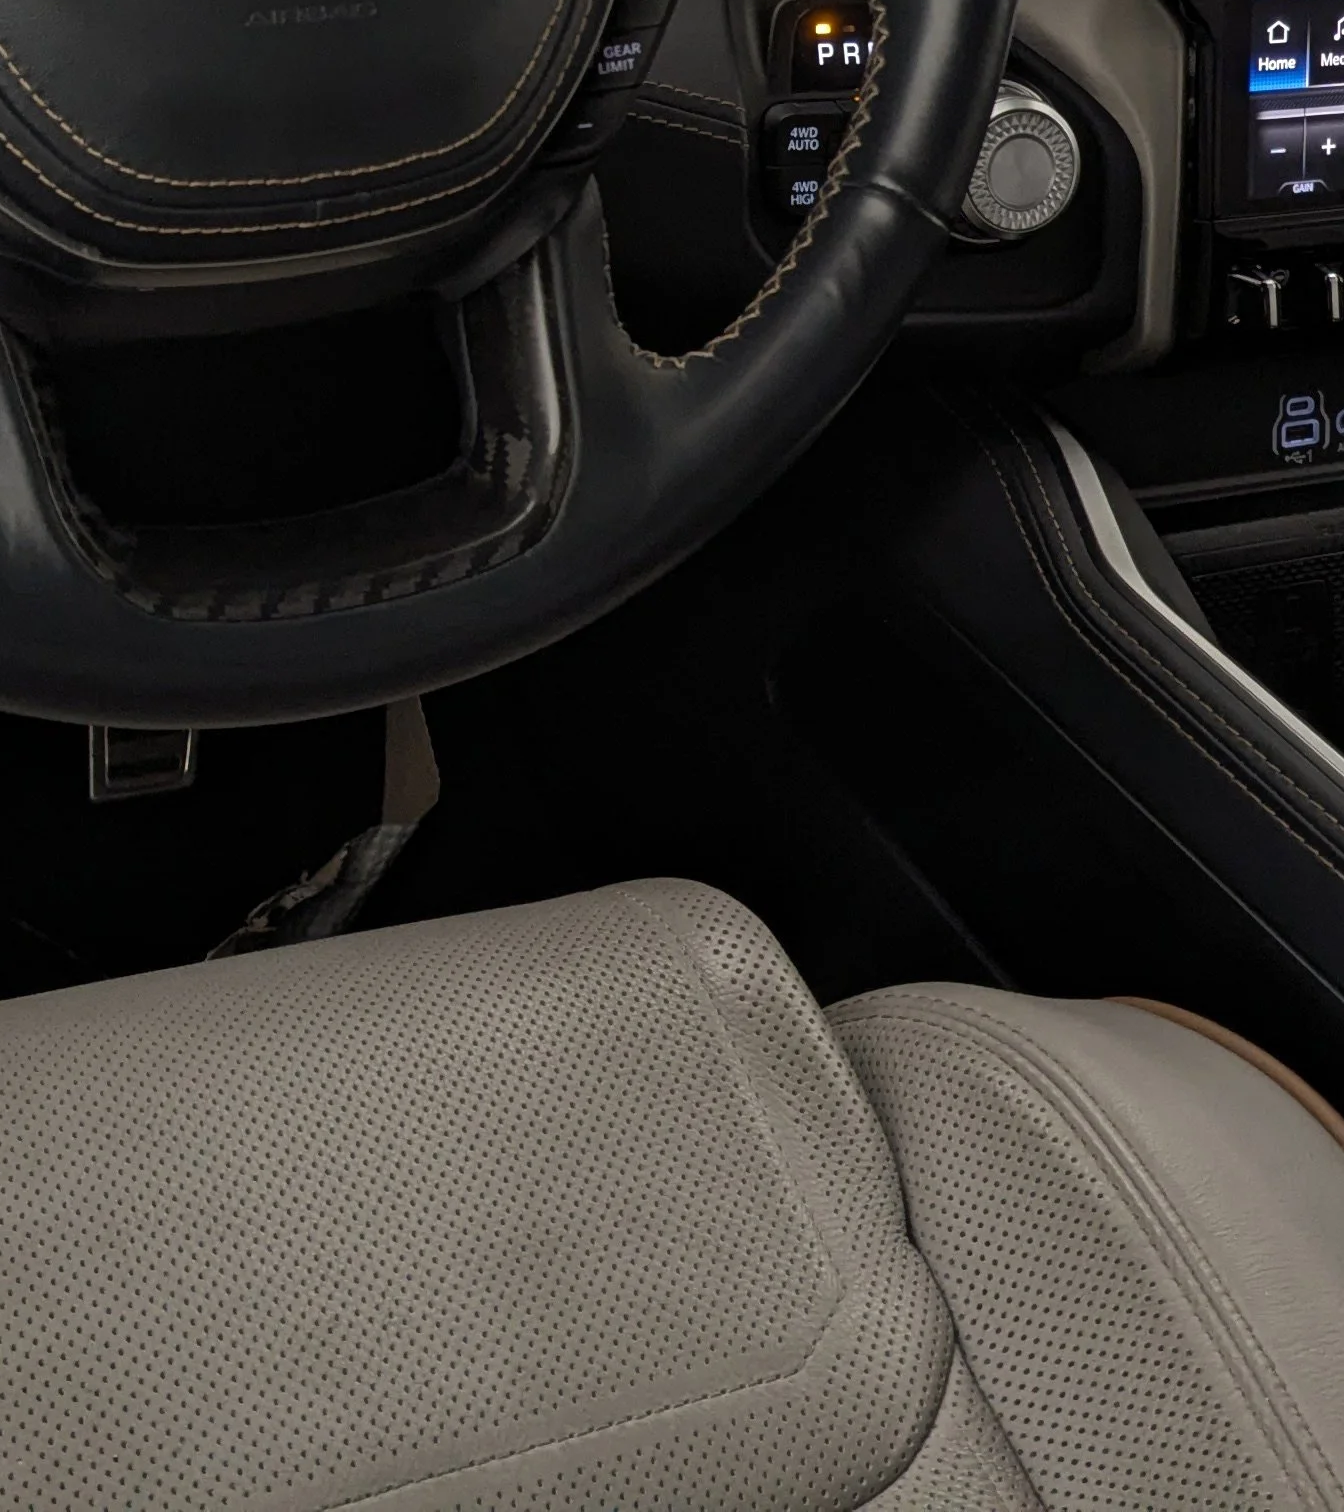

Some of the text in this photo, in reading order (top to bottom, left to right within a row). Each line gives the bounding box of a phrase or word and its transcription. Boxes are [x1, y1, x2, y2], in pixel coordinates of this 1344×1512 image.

[603, 42, 642, 59] GEAR
[817, 42, 834, 66] P
[842, 42, 861, 65] R
[597, 58, 635, 76] LIMIT
[1258, 57, 1296, 71] Home
[790, 127, 819, 139] 4WD
[787, 139, 820, 151] AUTO
[791, 180, 819, 193] 4WD
[1293, 183, 1314, 193] GAIN
